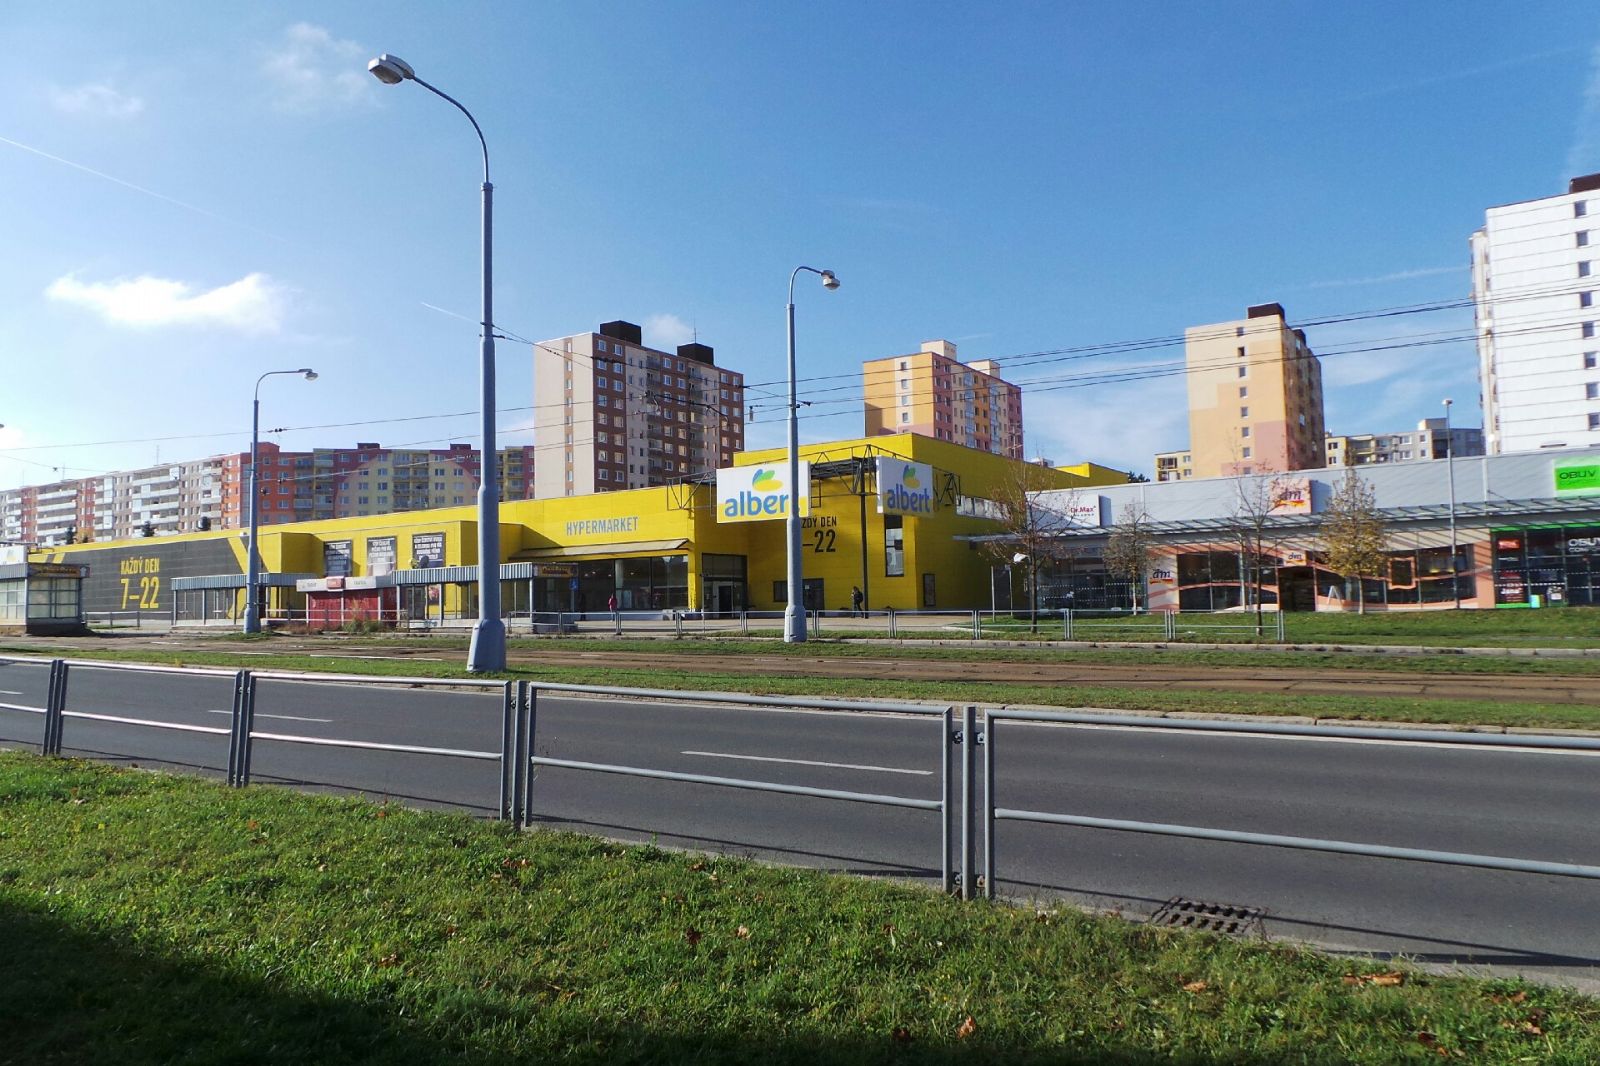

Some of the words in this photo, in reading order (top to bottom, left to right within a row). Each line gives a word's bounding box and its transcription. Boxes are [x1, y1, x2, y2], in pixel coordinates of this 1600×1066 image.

[1559, 470, 1596, 480] OBUV
[886, 483, 930, 513] albert
[1280, 488, 1302, 500] dm
[725, 491, 798, 517] alber
[566, 516, 638, 536] HYPERMARKET
[820, 516, 837, 527] DEN
[121, 556, 143, 574] KAŽDÝ
[145, 558, 160, 573] DEN
[1153, 568, 1171, 579] dm
